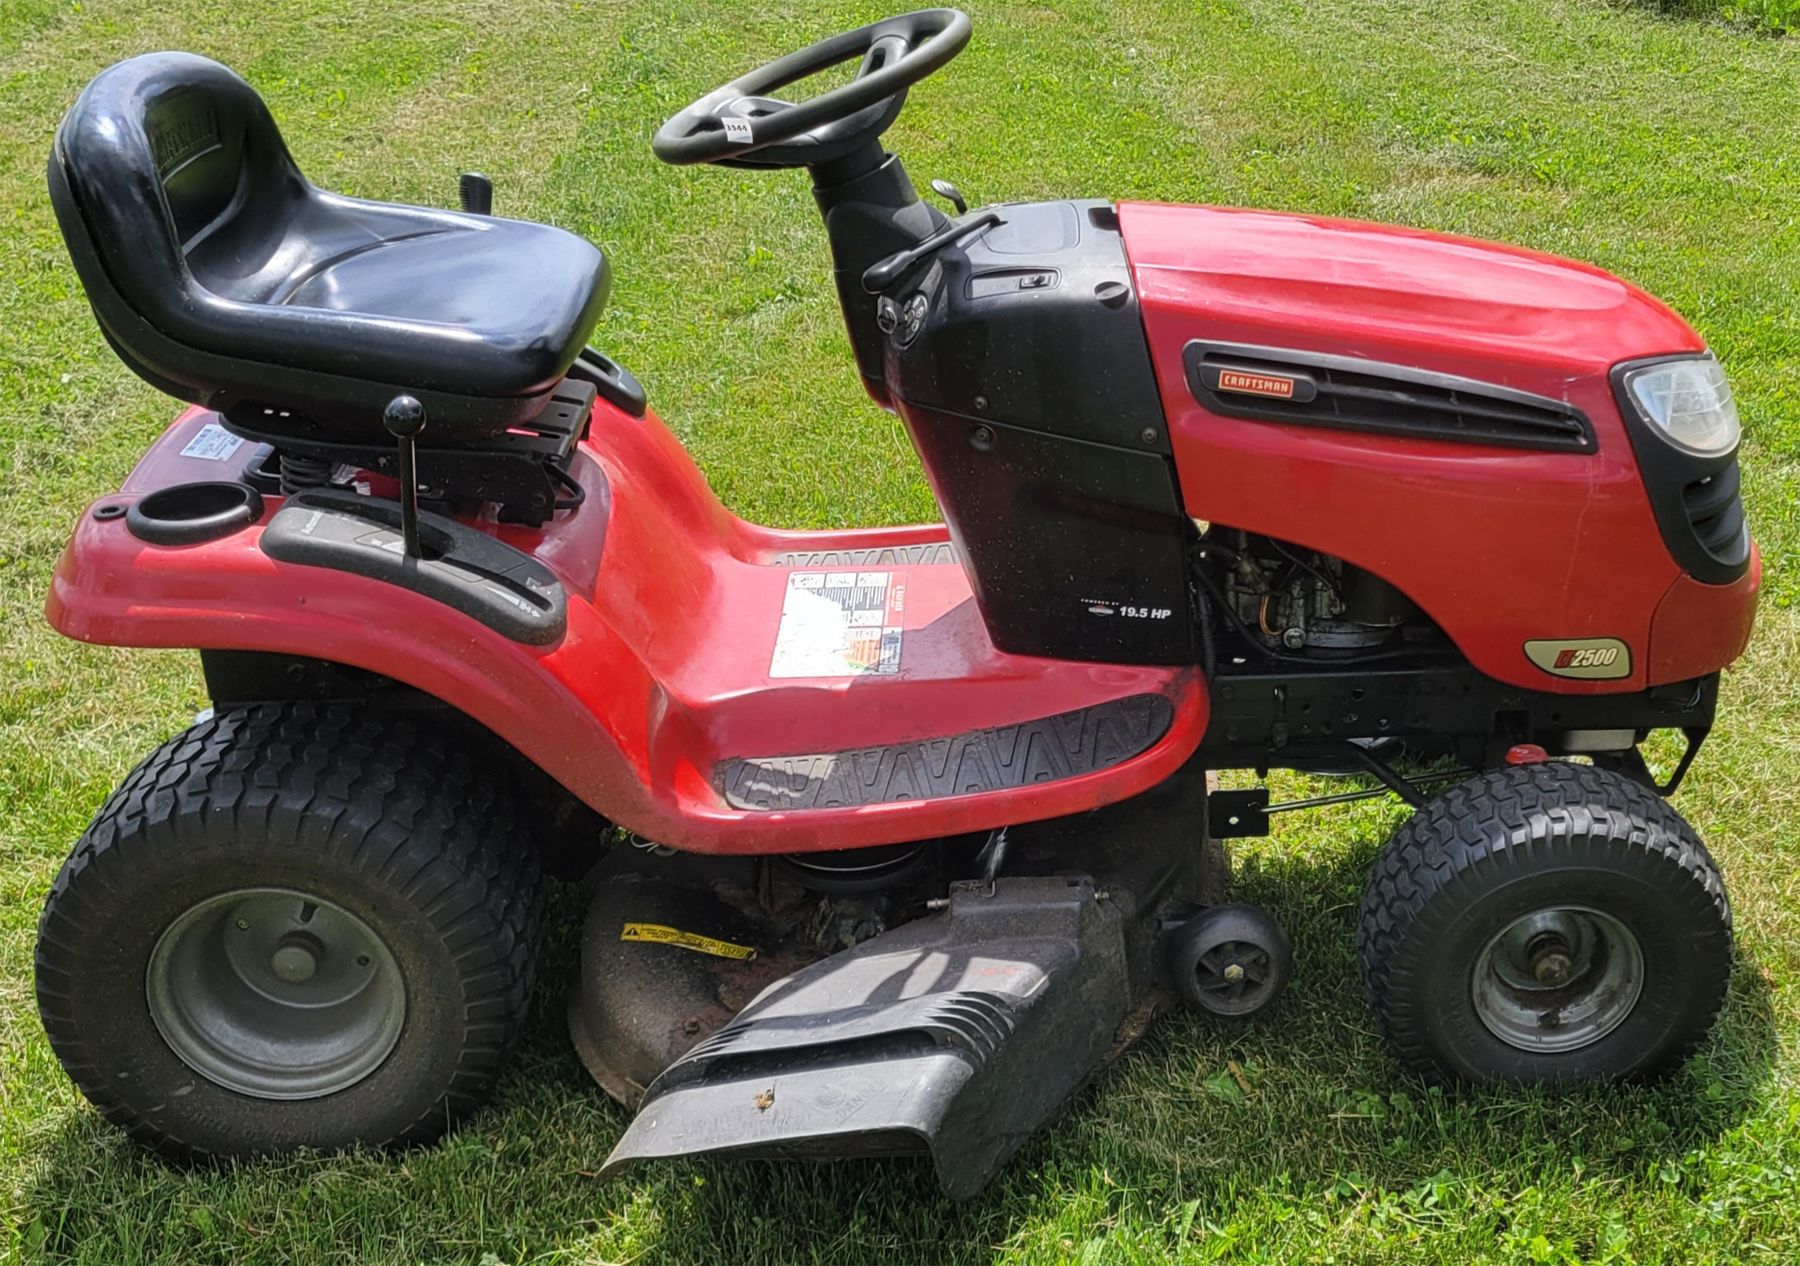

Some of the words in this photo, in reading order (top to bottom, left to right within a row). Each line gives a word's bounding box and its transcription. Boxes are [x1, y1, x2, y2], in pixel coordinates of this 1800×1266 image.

[726, 124, 748, 132] 3544
[1224, 375, 1289, 393] CRAFTSMAN
[1120, 606, 1148, 618] 19.5
[1151, 608, 1172, 619] HP
